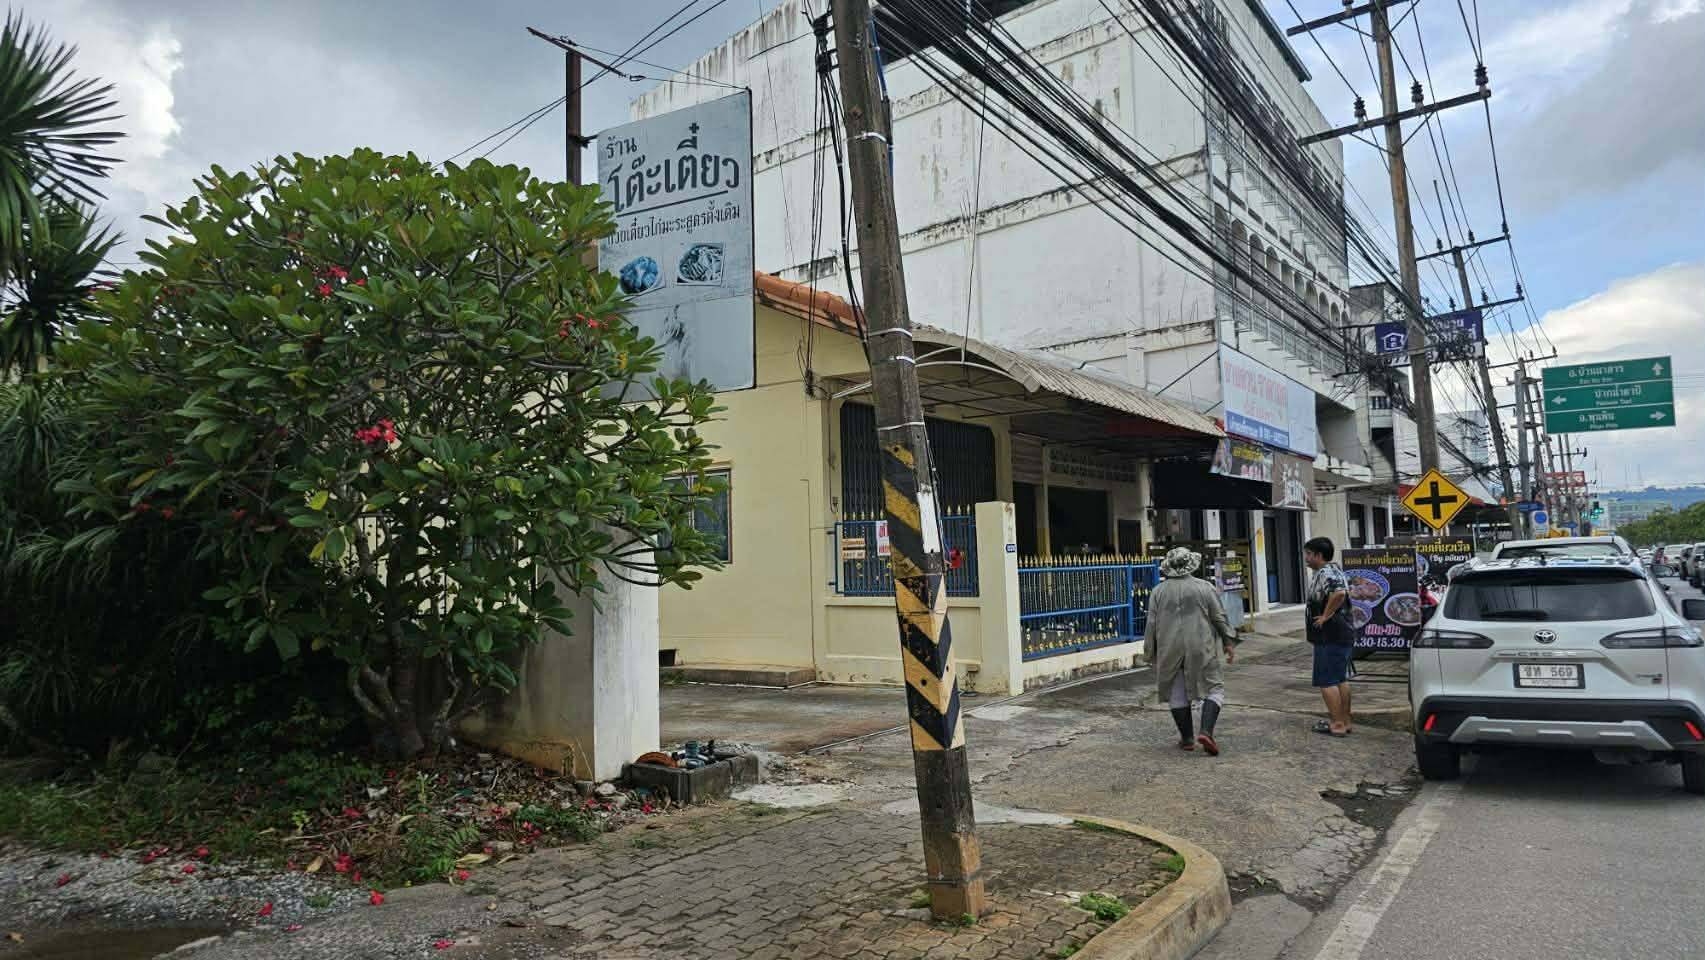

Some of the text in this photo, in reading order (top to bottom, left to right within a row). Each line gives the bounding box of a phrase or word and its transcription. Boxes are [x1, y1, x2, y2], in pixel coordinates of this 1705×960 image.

[606, 136, 637, 159] ร้าน
[607, 122, 740, 213] โต๊ะเตี๋ยว
[1551, 666, 1573, 677] 569
